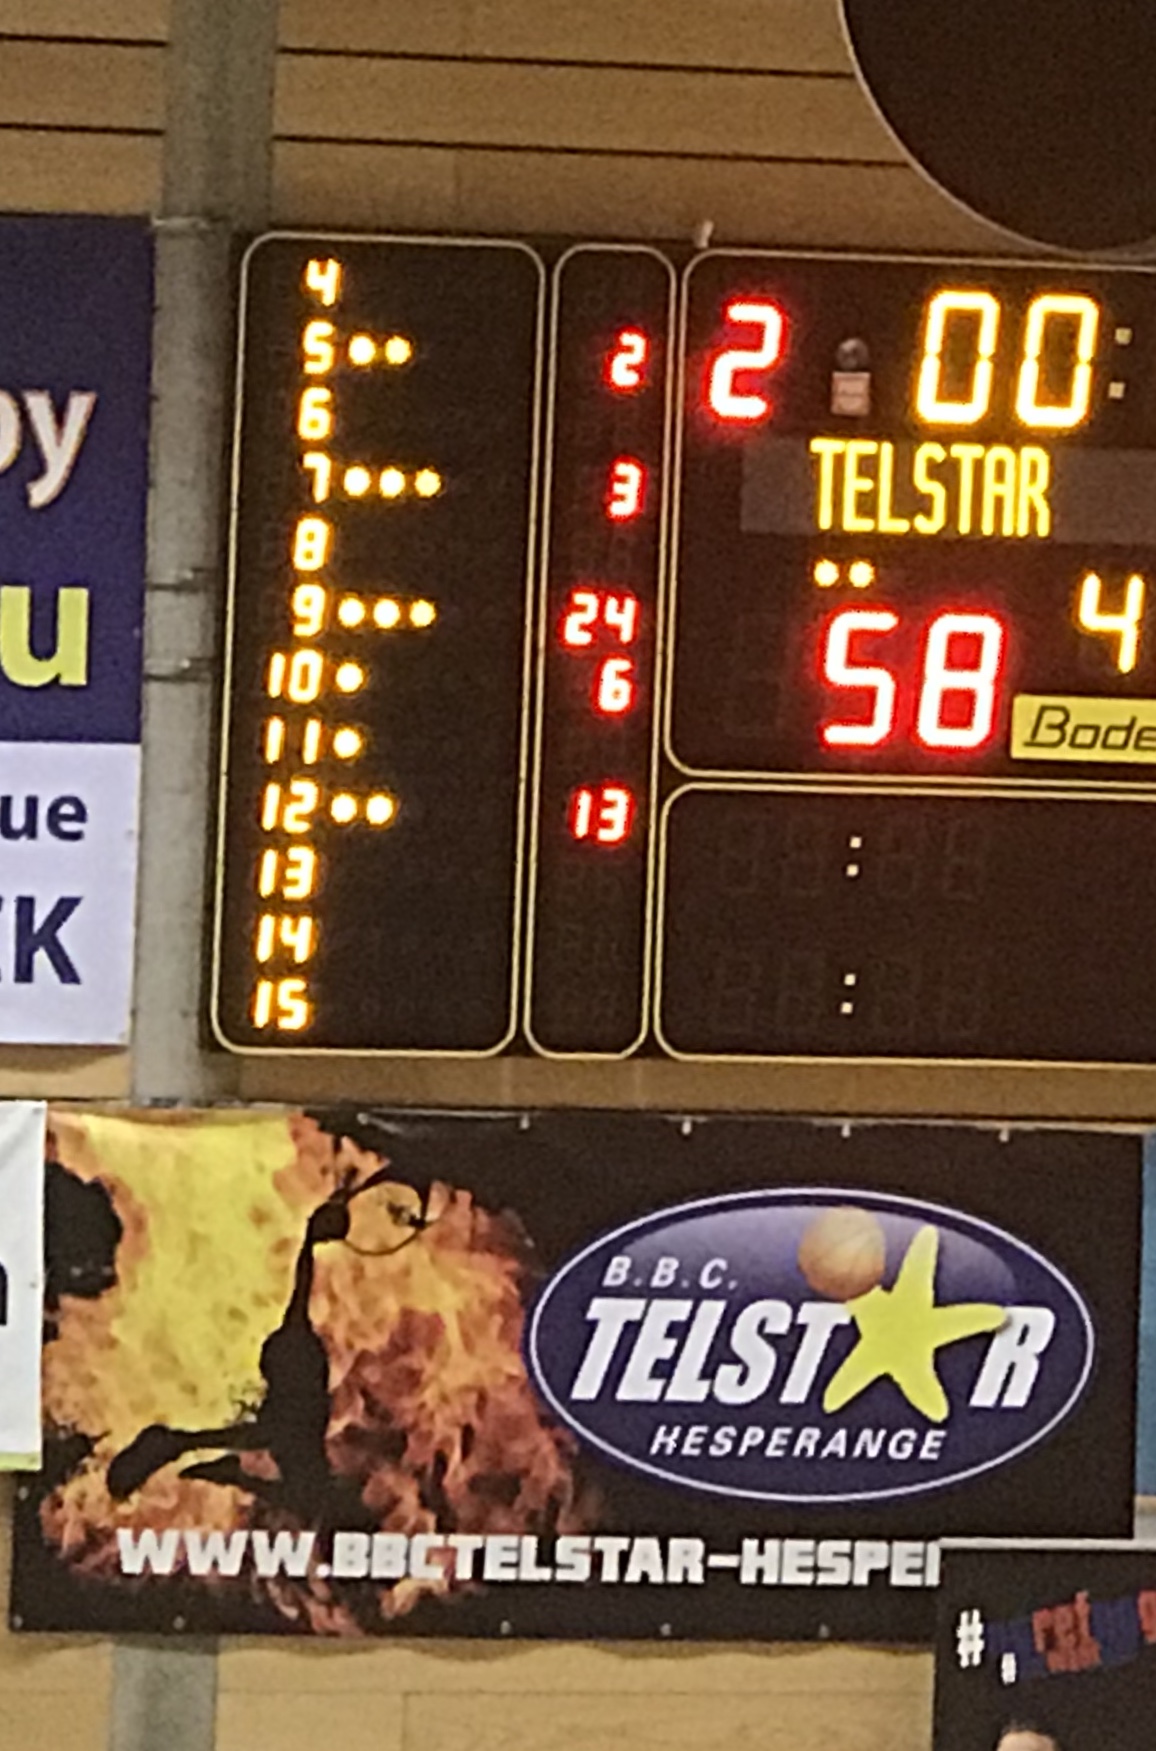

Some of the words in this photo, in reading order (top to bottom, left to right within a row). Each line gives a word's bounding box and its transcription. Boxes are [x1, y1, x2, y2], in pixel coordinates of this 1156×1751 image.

[305, 258, 341, 307] 4
[302, 319, 336, 377] 5
[604, 328, 650, 391] 2
[706, 300, 786, 422] 2
[297, 386, 334, 442] 6
[301, 450, 333, 504] 7
[606, 458, 646, 523] 3
[809, 437, 1052, 539] TELSTAR
[292, 514, 332, 572] 8
[291, 581, 328, 639] 9
[563, 592, 636, 646] 24
[1077, 572, 1145, 675] 4
[266, 646, 323, 704] 10
[598, 658, 632, 712] 6
[819, 607, 1007, 753] 58
[263, 713, 323, 767] 11
[0, 795, 88, 842] ue
[261, 776, 319, 835] 12
[575, 787, 632, 843] 13
[257, 843, 319, 902] 13
[254, 911, 316, 965] 14
[251, 976, 312, 1032] 15
[602, 1256, 739, 1290] B.B.C.
[650, 1425, 946, 1461] HESPERANGE
